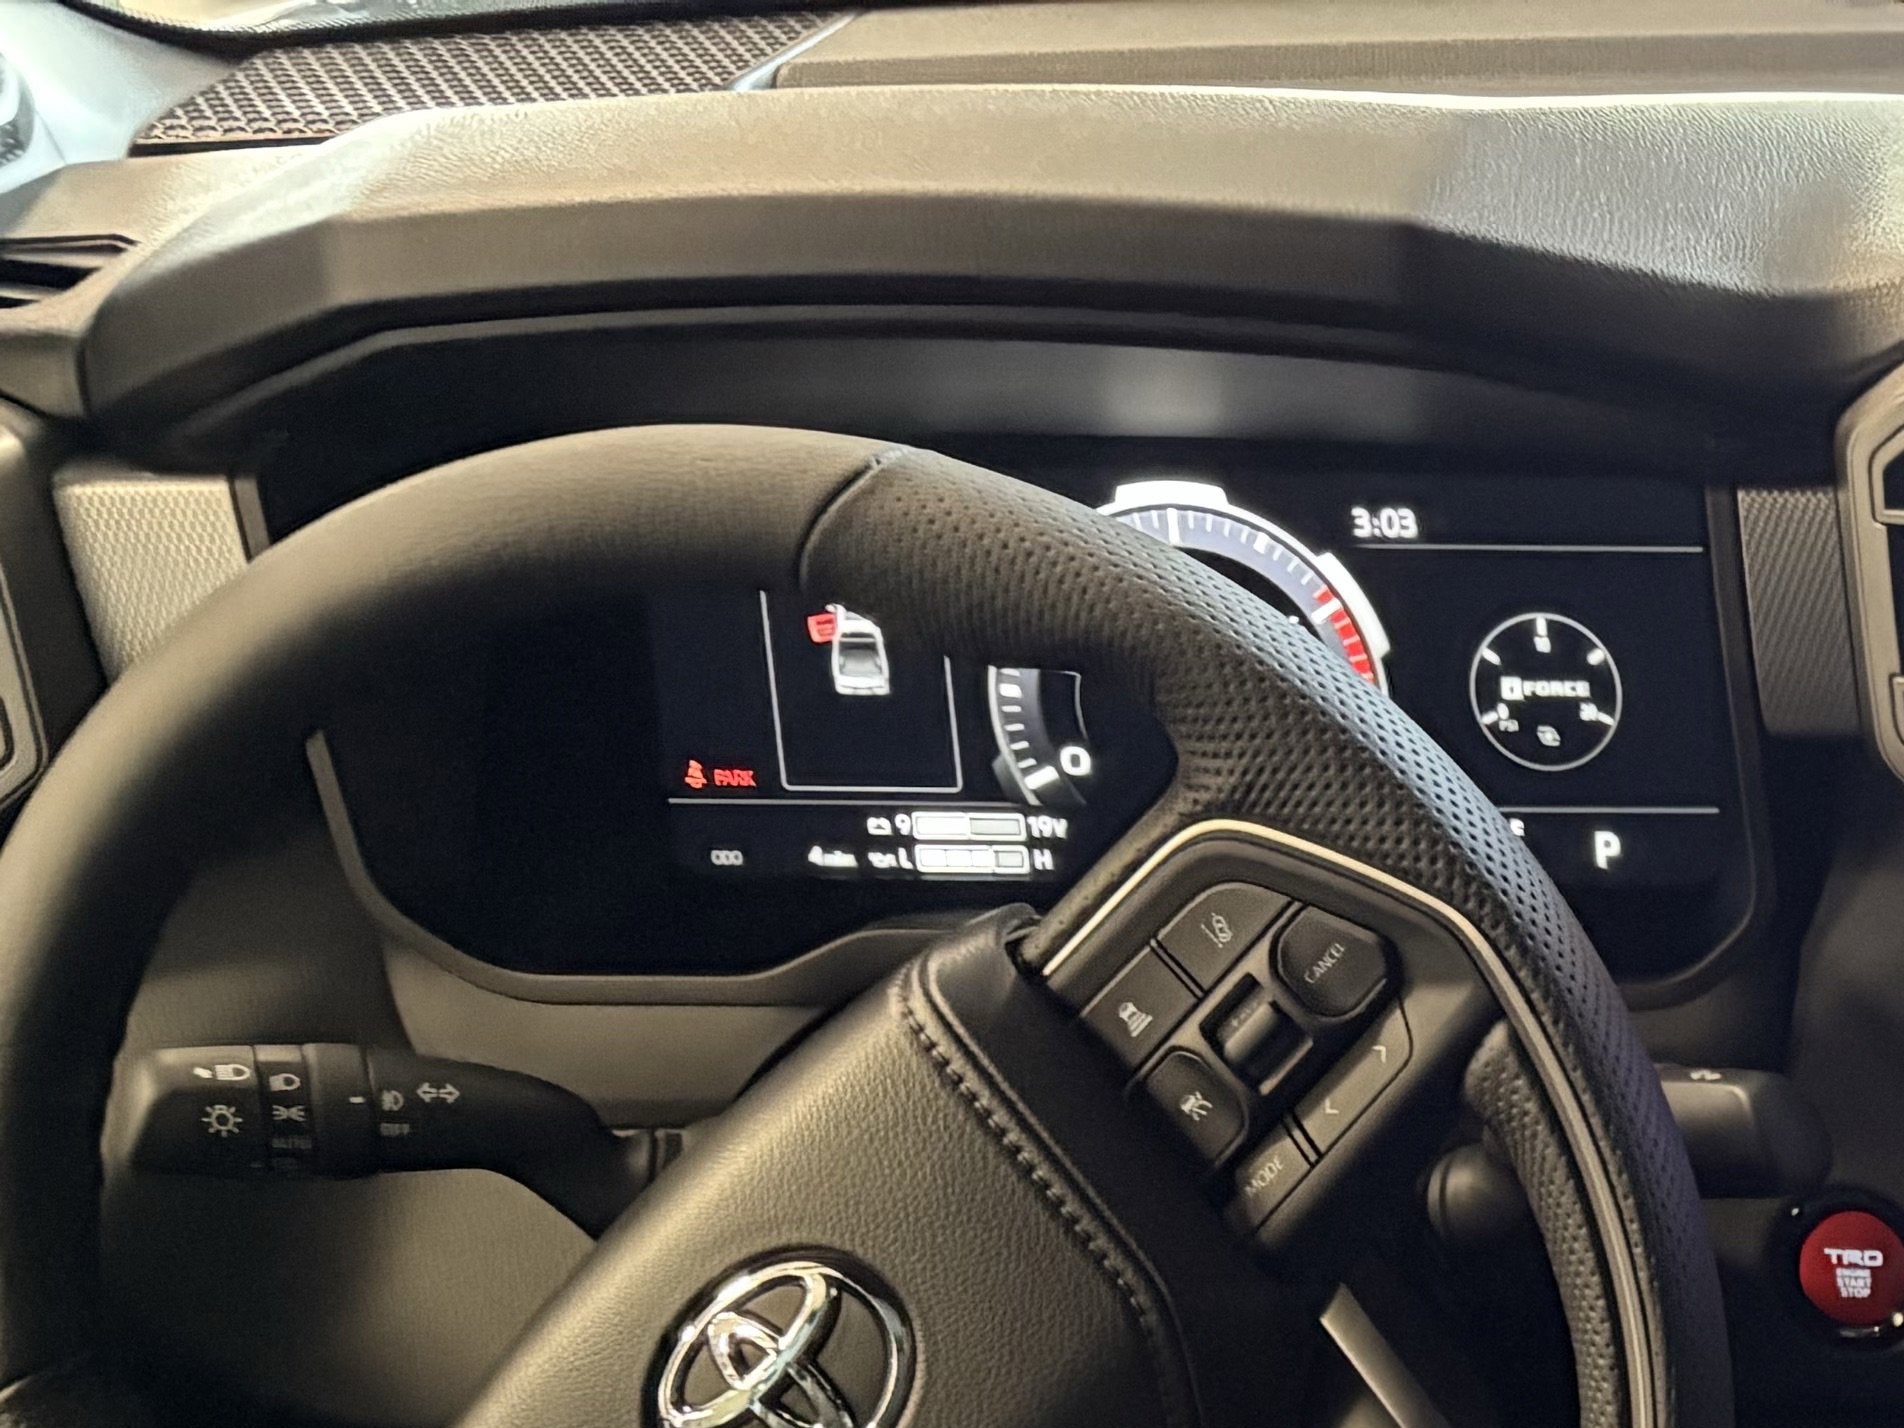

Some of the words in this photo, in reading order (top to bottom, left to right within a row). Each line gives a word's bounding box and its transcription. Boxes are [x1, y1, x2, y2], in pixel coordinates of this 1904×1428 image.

[1351, 507, 1418, 539] 3:03
[1033, 848, 1054, 871] H
[1594, 831, 1622, 868] P
[1303, 942, 1346, 984] CANCEL
[1243, 1155, 1286, 1199] MODE
[1823, 1247, 1884, 1268] TRD
[1837, 1277, 1872, 1288] START
[1840, 1287, 1872, 1298] STOP
